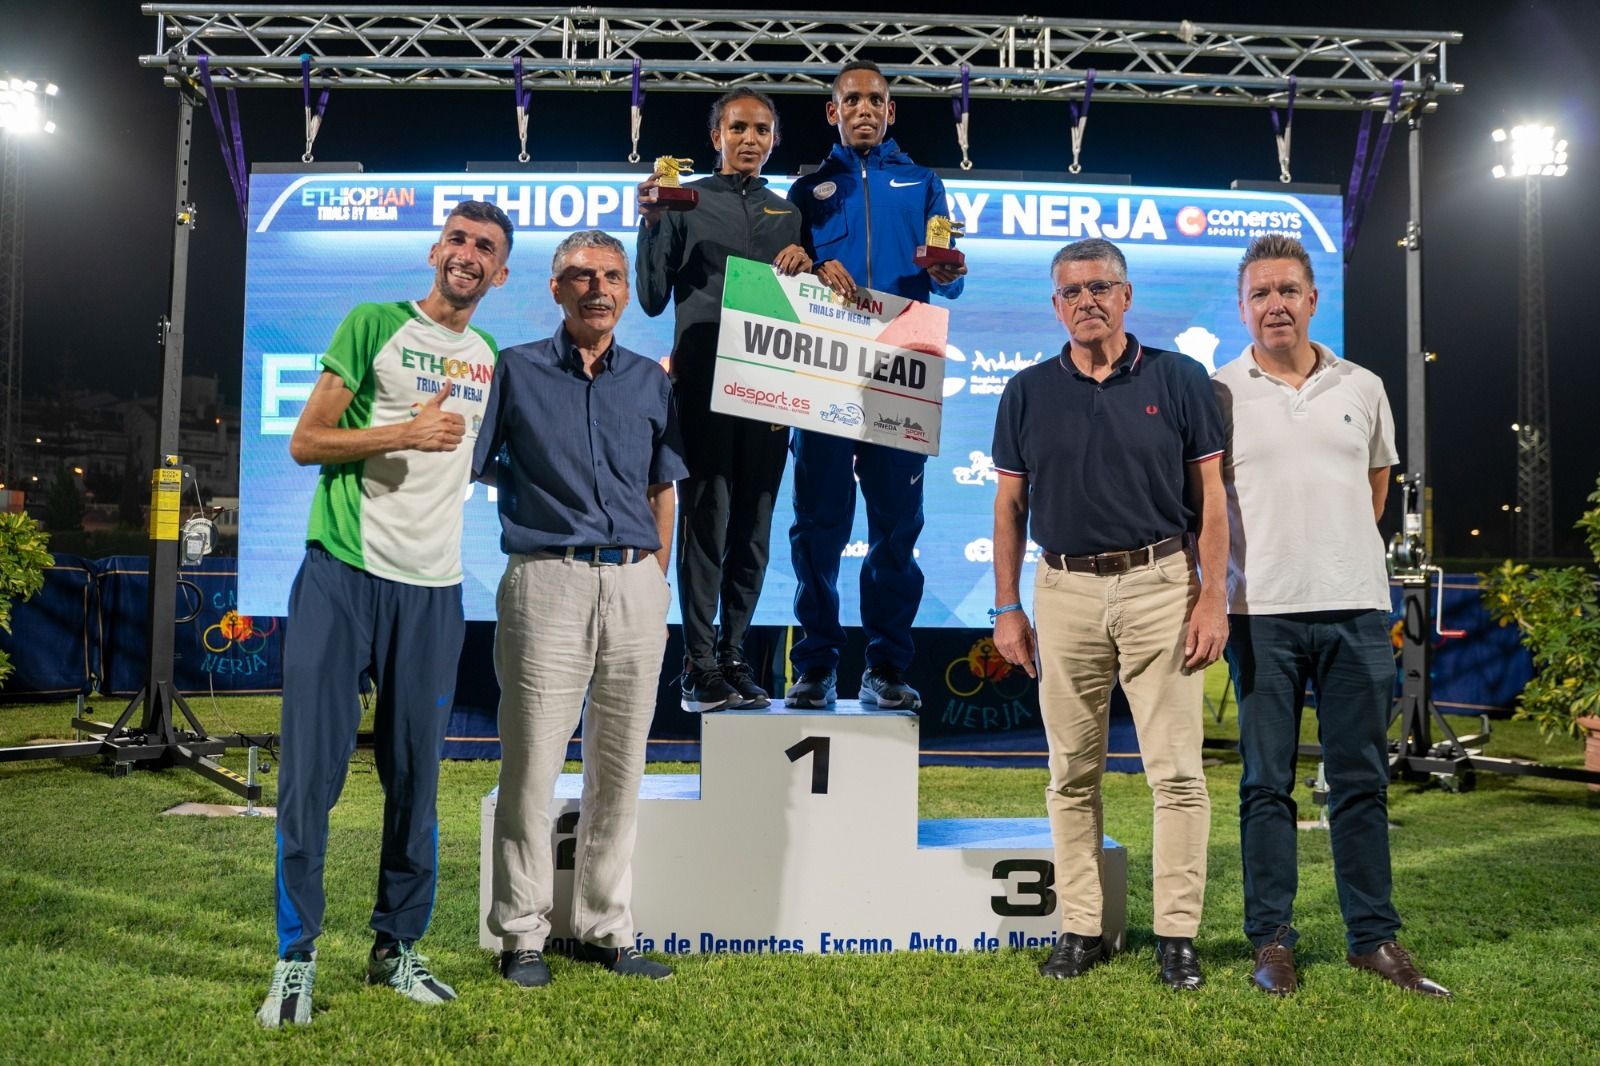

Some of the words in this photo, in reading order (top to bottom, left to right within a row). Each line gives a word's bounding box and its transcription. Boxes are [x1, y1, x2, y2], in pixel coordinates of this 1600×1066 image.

[302, 187, 415, 206] ETHIOPIAN
[352, 206, 365, 220] BY
[433, 185, 643, 227] ETHIOPI
[1002, 193, 1168, 240] NERJA
[1207, 209, 1302, 229] conersys
[1207, 228, 1246, 237] SPORTS
[809, 302, 834, 318] TRIALS
[836, 310, 846, 321] BY
[847, 311, 871, 326] NERJA
[402, 346, 493, 384] ETHIOPIAN
[744, 321, 848, 373] WORLD
[857, 347, 927, 390] LEAD
[450, 383, 461, 398] BY
[463, 385, 483, 403] NERJA
[724, 382, 810, 410] alssport.es
[873, 421, 897, 431] PINEDA
[905, 428, 926, 438] SPORT
[200, 653, 267, 675] NERJA
[941, 699, 1032, 730] NERJA
[785, 736, 830, 794] 1
[991, 858, 1057, 916] 3
[664, 932, 691, 954] de
[700, 932, 804, 955] Deportes
[974, 931, 999, 953] de
